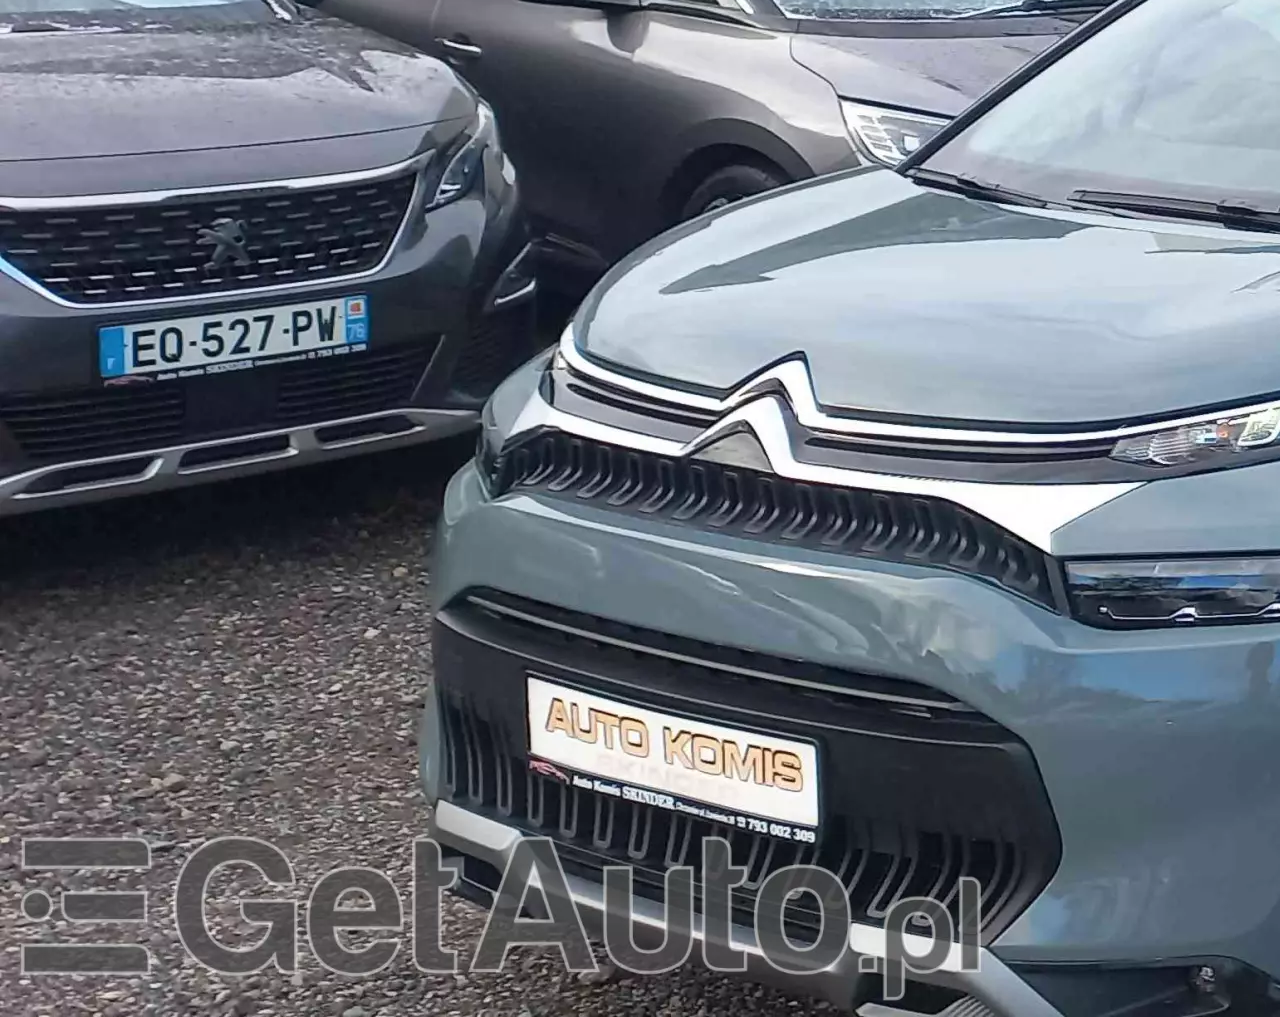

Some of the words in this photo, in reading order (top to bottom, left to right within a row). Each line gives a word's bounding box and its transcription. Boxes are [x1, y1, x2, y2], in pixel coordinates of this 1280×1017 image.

[132, 306, 337, 368] EQ-527-PW
[545, 697, 650, 758] AUTO
[663, 724, 804, 793] KOMIS
